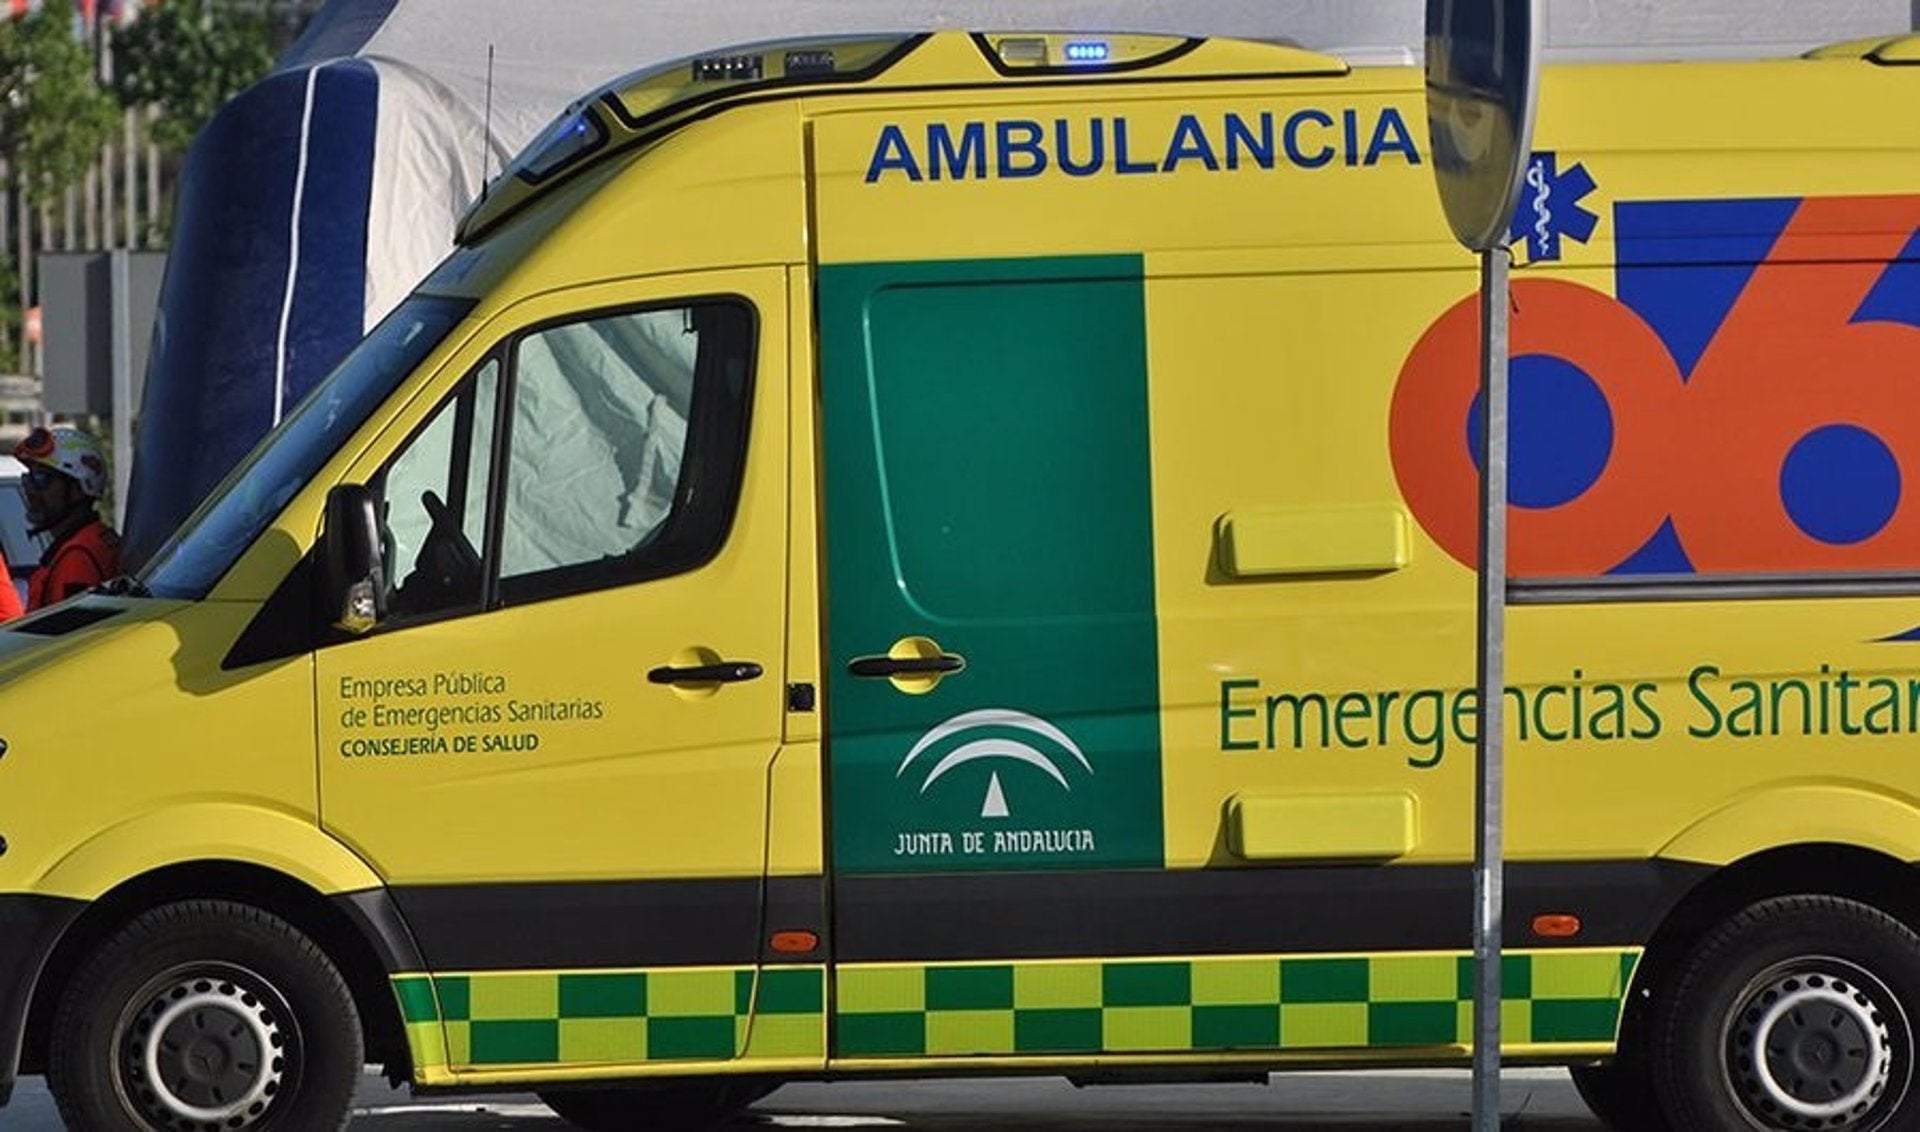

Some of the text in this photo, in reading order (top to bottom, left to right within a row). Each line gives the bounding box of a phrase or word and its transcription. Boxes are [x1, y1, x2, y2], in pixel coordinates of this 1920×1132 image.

[864, 107, 1422, 184] AMBULANCIA
[340, 673, 506, 703] Empresa Pública
[340, 699, 604, 731] de Emergencias Sanitarias
[1220, 670, 1663, 769] Emergencias
[340, 733, 540, 757] CONSEJERÍA DE SALUD
[894, 829, 1095, 855] JUNTA DE ANDALUCIA
